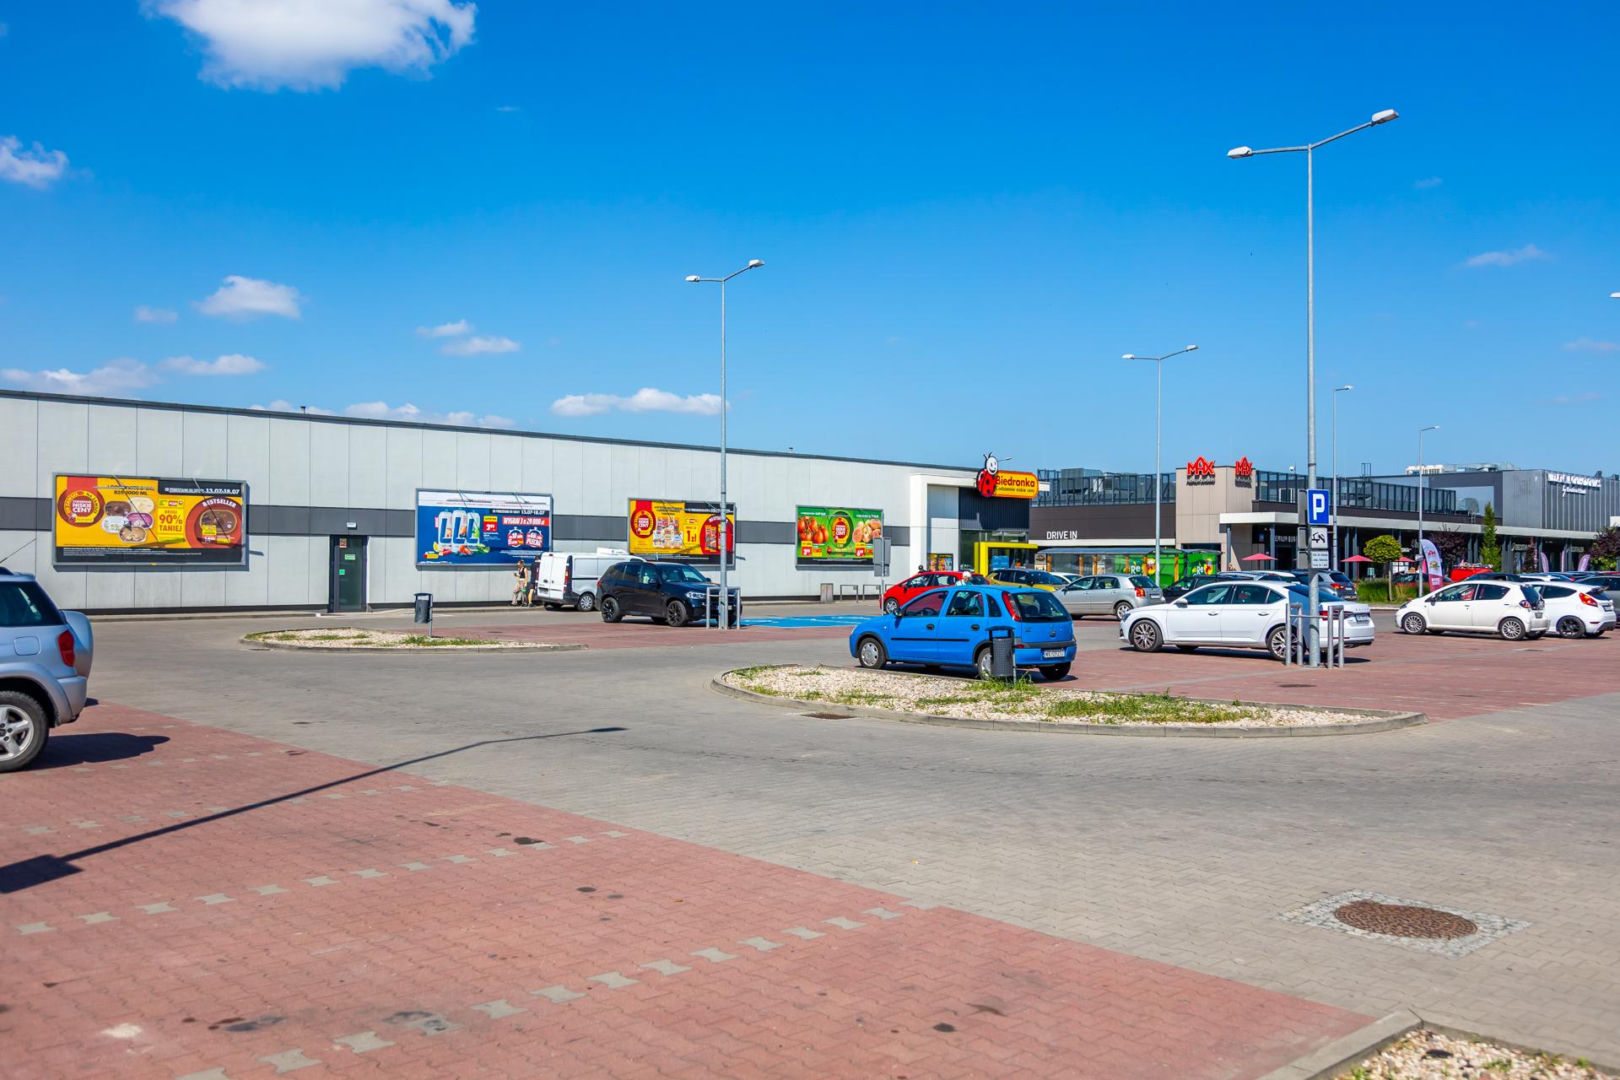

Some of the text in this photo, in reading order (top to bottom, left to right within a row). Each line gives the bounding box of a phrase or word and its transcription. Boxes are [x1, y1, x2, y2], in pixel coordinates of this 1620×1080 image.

[1187, 456, 1214, 475] MAX
[1235, 456, 1252, 476] MAX
[996, 475, 1035, 488] Biedronka
[202, 498, 237, 508] BESTSELLER
[1313, 493, 1325, 520] P
[159, 514, 183, 524] 90%
[1046, 530, 1078, 540] DRIVE IN
